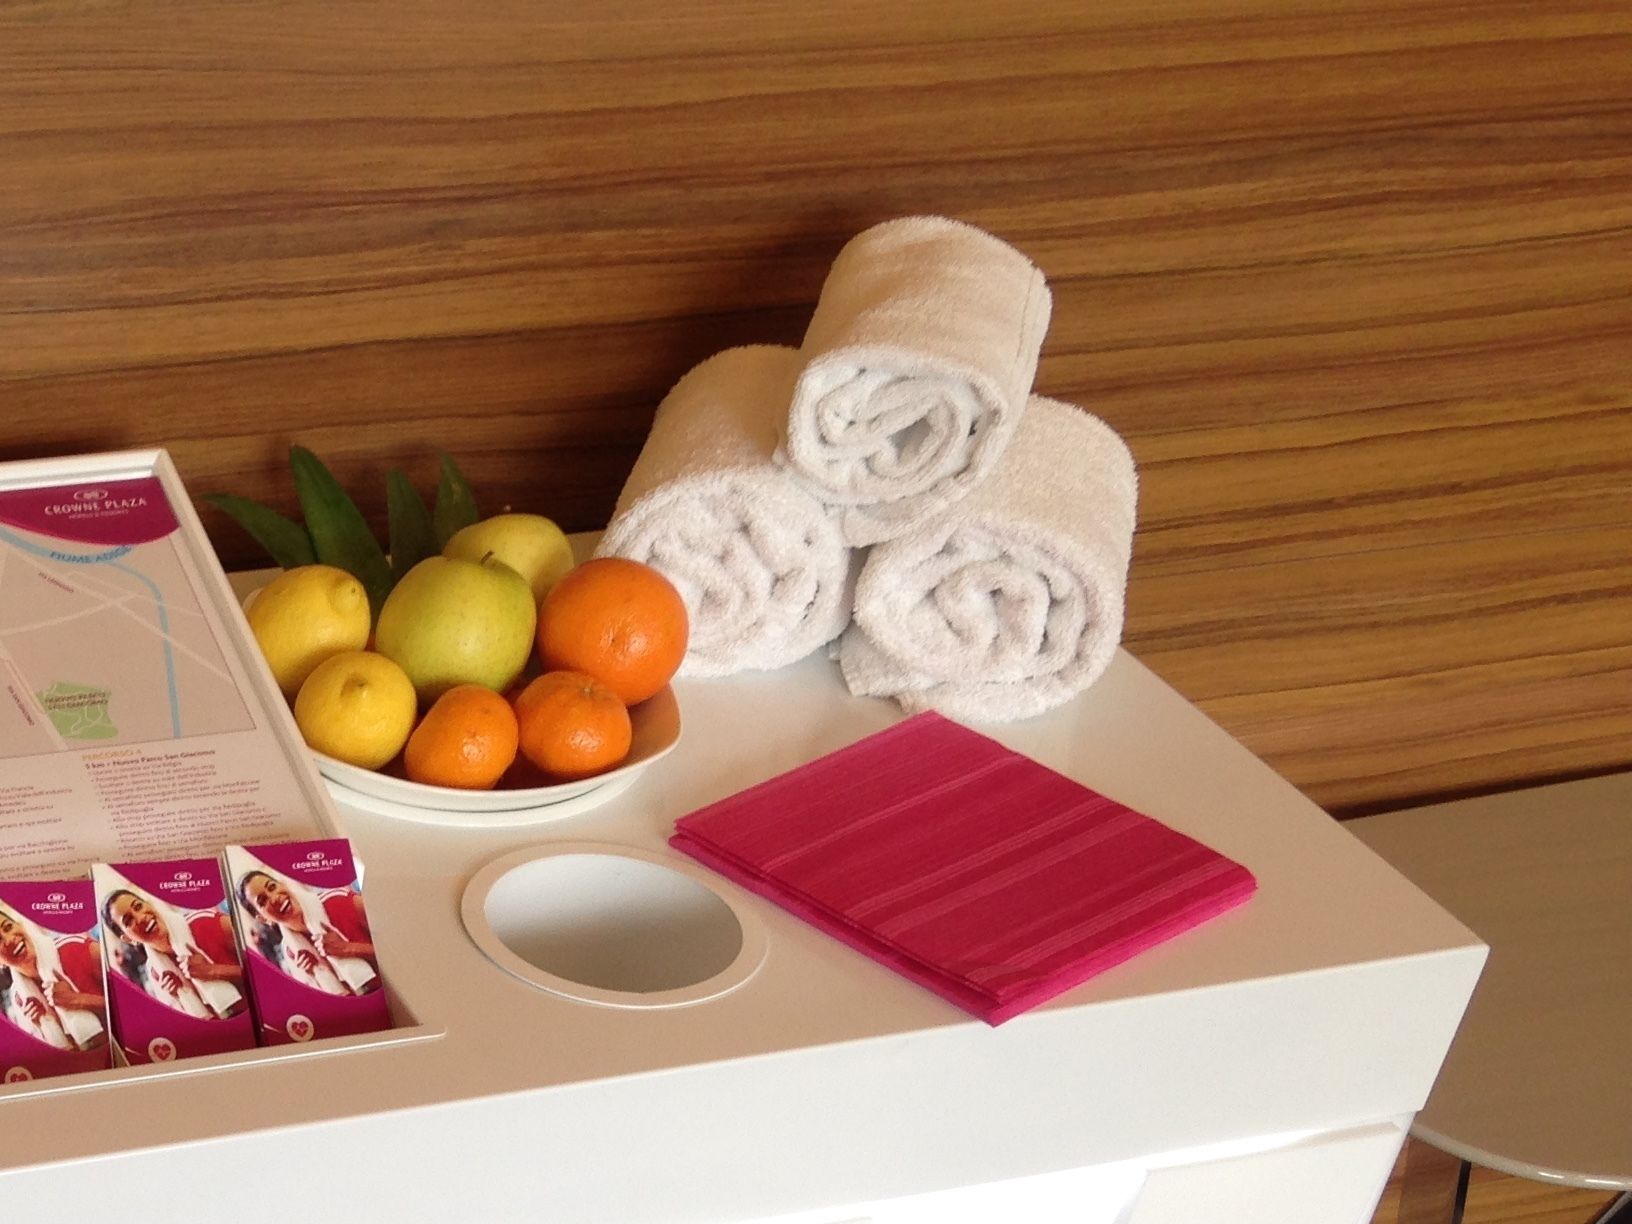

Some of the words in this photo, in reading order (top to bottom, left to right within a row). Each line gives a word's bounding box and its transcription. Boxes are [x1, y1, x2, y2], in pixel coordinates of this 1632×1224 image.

[44, 501, 100, 516] CROWNE
[104, 497, 147, 511] PLAZA
[50, 551, 92, 564] FIUME
[292, 862, 319, 870] CROWNE
[321, 859, 343, 867] PLAZA
[159, 881, 187, 889] CROWNE
[189, 879, 210, 887] PLAZA
[32, 903, 60, 911] CROWNE
[61, 902, 84, 910] PLAZA
